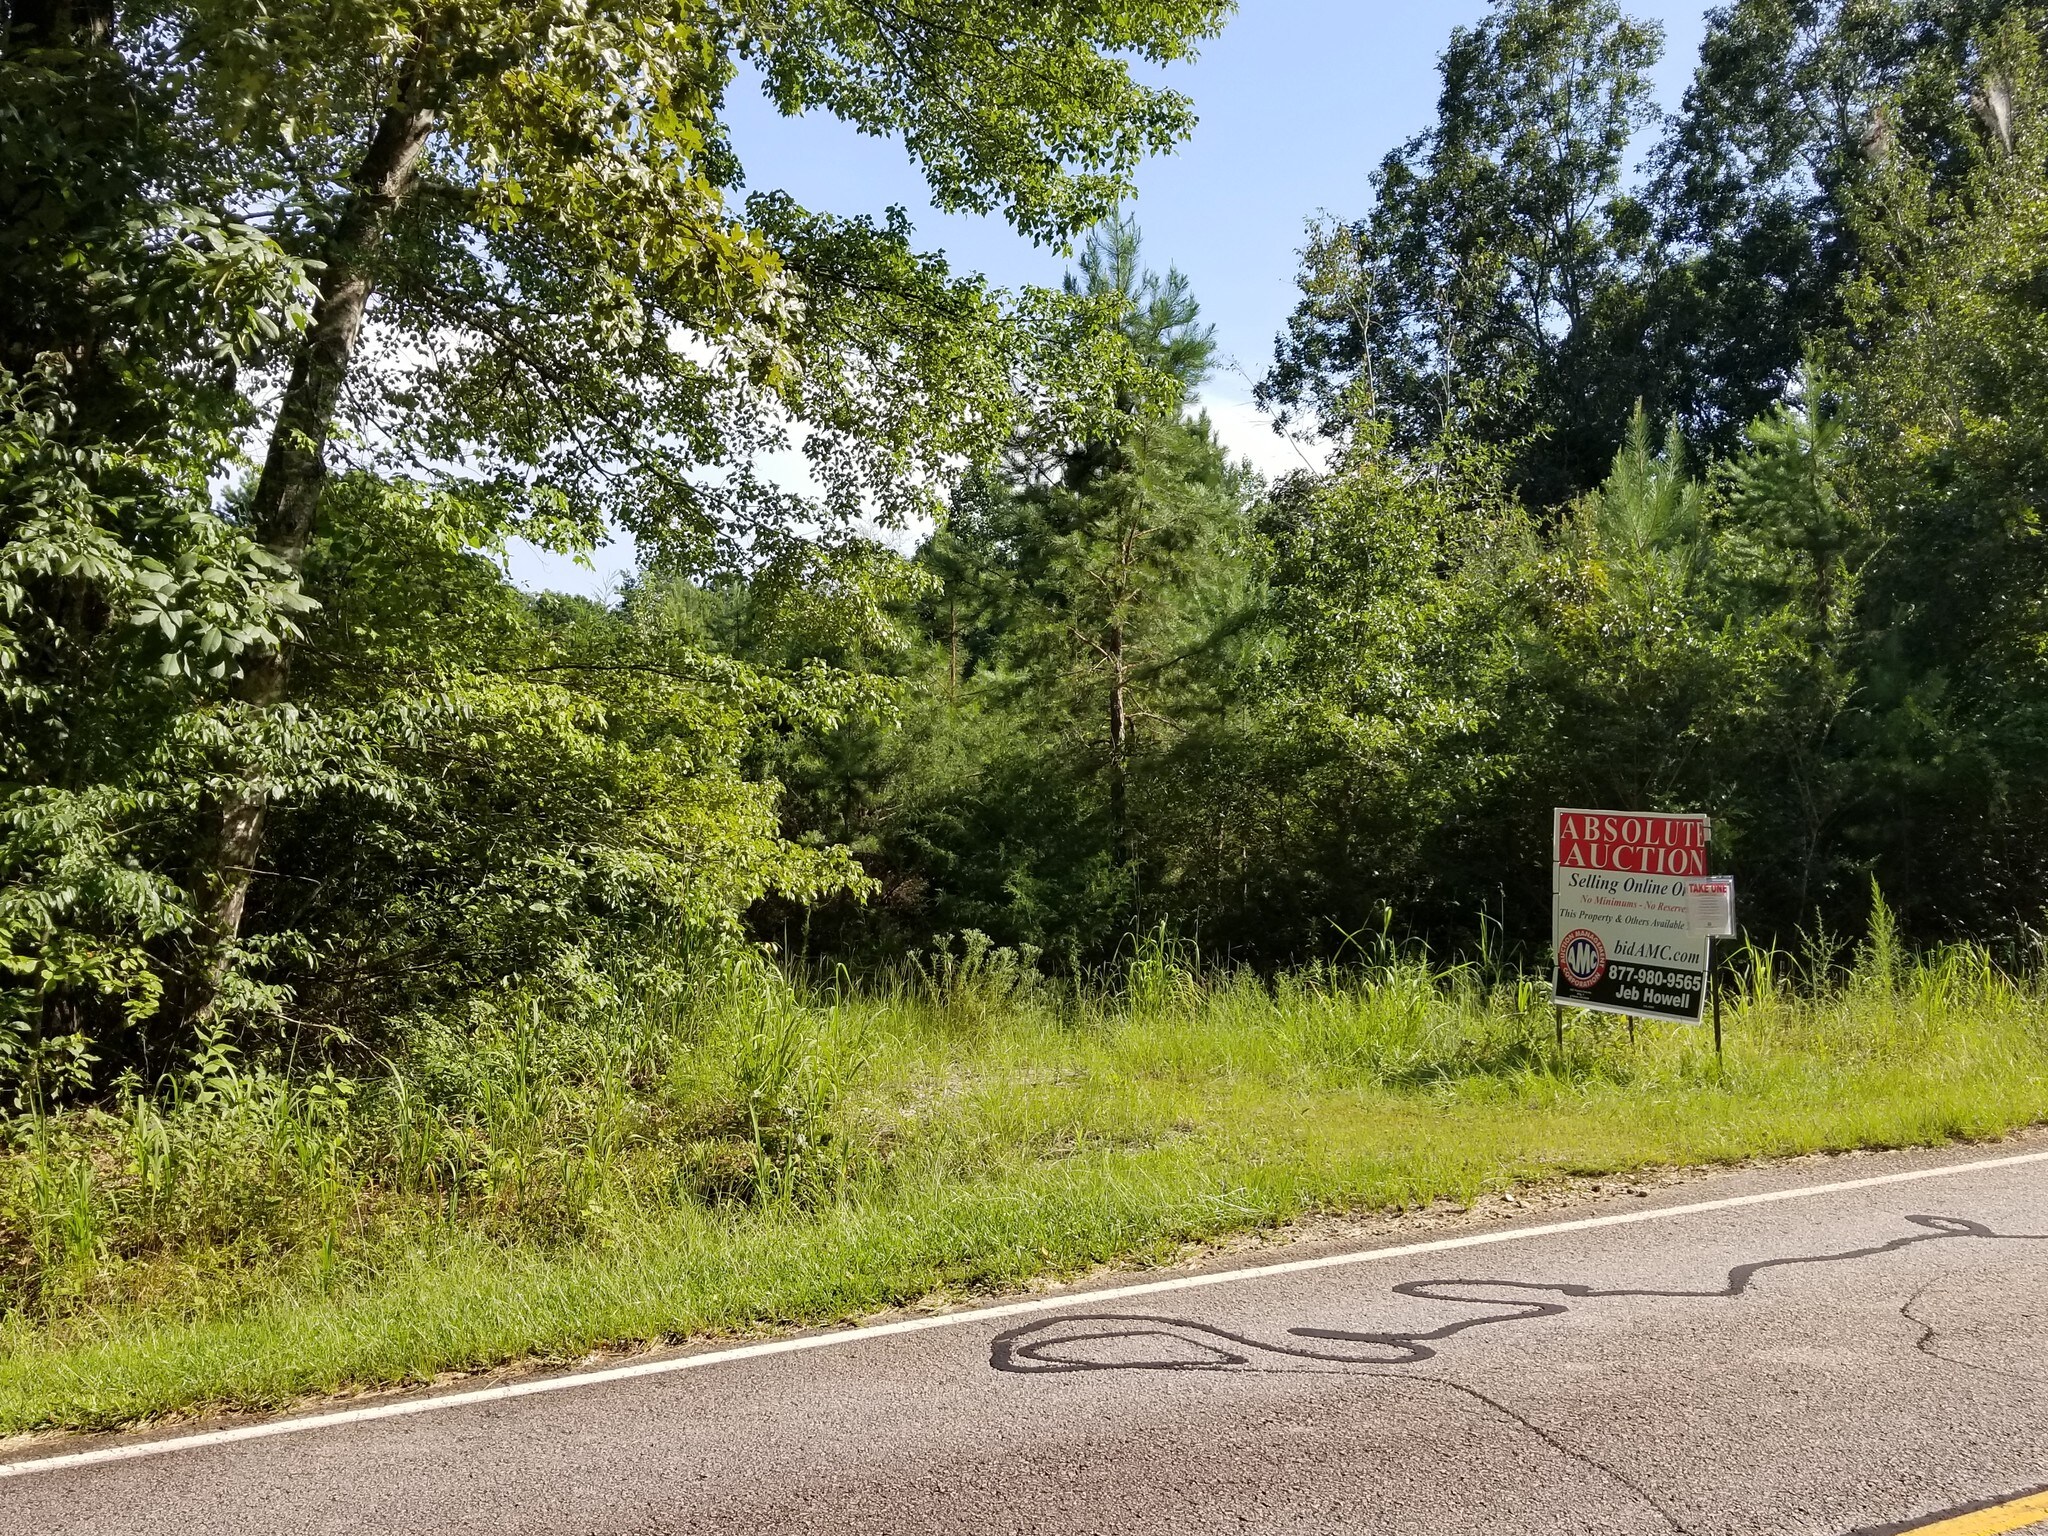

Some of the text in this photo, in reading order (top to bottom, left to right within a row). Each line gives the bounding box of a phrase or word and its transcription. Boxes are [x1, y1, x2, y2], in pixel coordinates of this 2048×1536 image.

[1561, 815, 1705, 848] ABSOLUTE
[1564, 842, 1704, 875] AUCTION
[1568, 872, 1619, 894] Selling
[1623, 877, 1668, 895] Online
[1689, 883, 1709, 893] TAKE
[1580, 894, 1592, 904] No
[1594, 896, 1637, 908] Minimums
[1645, 900, 1656, 910] No
[1560, 908, 1577, 918] This
[1579, 910, 1613, 924] Property
[1615, 914, 1622, 923] &
[1625, 915, 1650, 926] Others
[1651, 918, 1685, 930] Available
[1560, 933, 1575, 963] AUCTION
[1568, 942, 1597, 975] AMC
[1614, 939, 1700, 964] bidAMC.com
[1563, 967, 1600, 988] CORPORATION
[1609, 965, 1702, 992] 877-980-9565
[1615, 984, 1640, 1001] Jeb
[1643, 987, 1690, 1009] Howell
